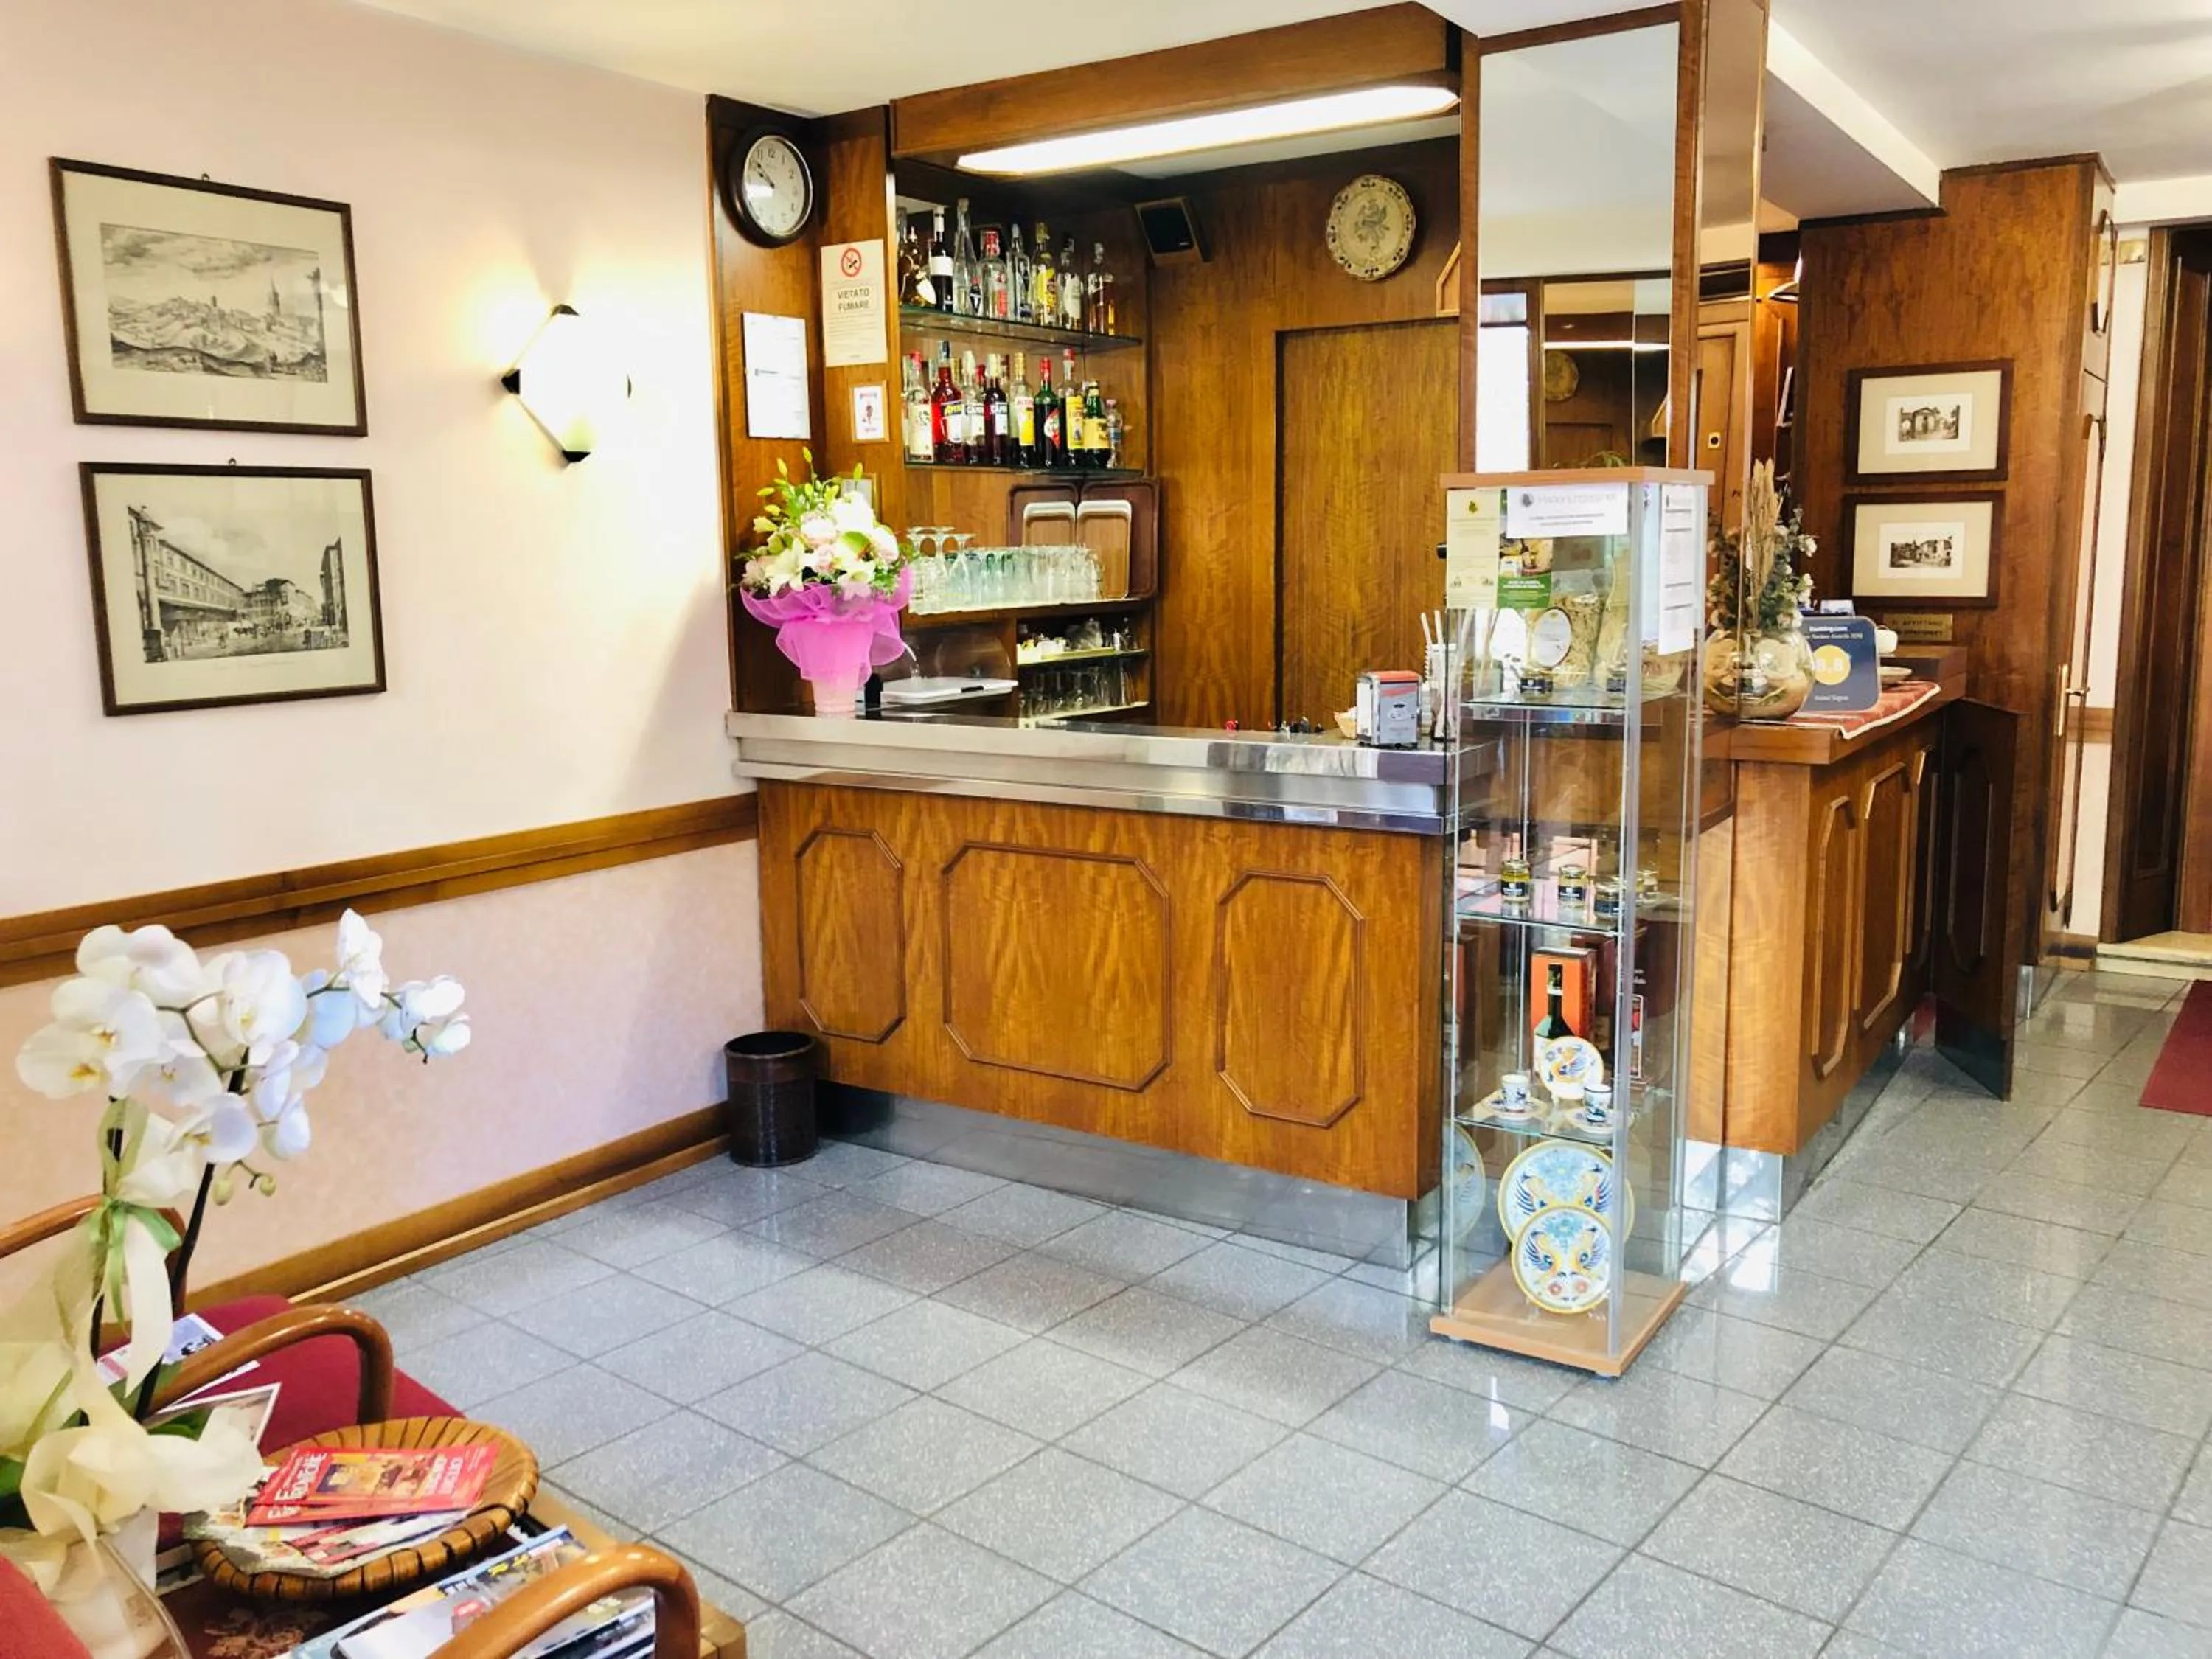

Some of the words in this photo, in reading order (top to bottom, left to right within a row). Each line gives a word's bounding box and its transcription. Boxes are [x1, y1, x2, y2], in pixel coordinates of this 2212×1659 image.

[768, 148, 776, 159] 12
[838, 288, 869, 299] VIETATO
[838, 300, 870, 312] FUMARE
